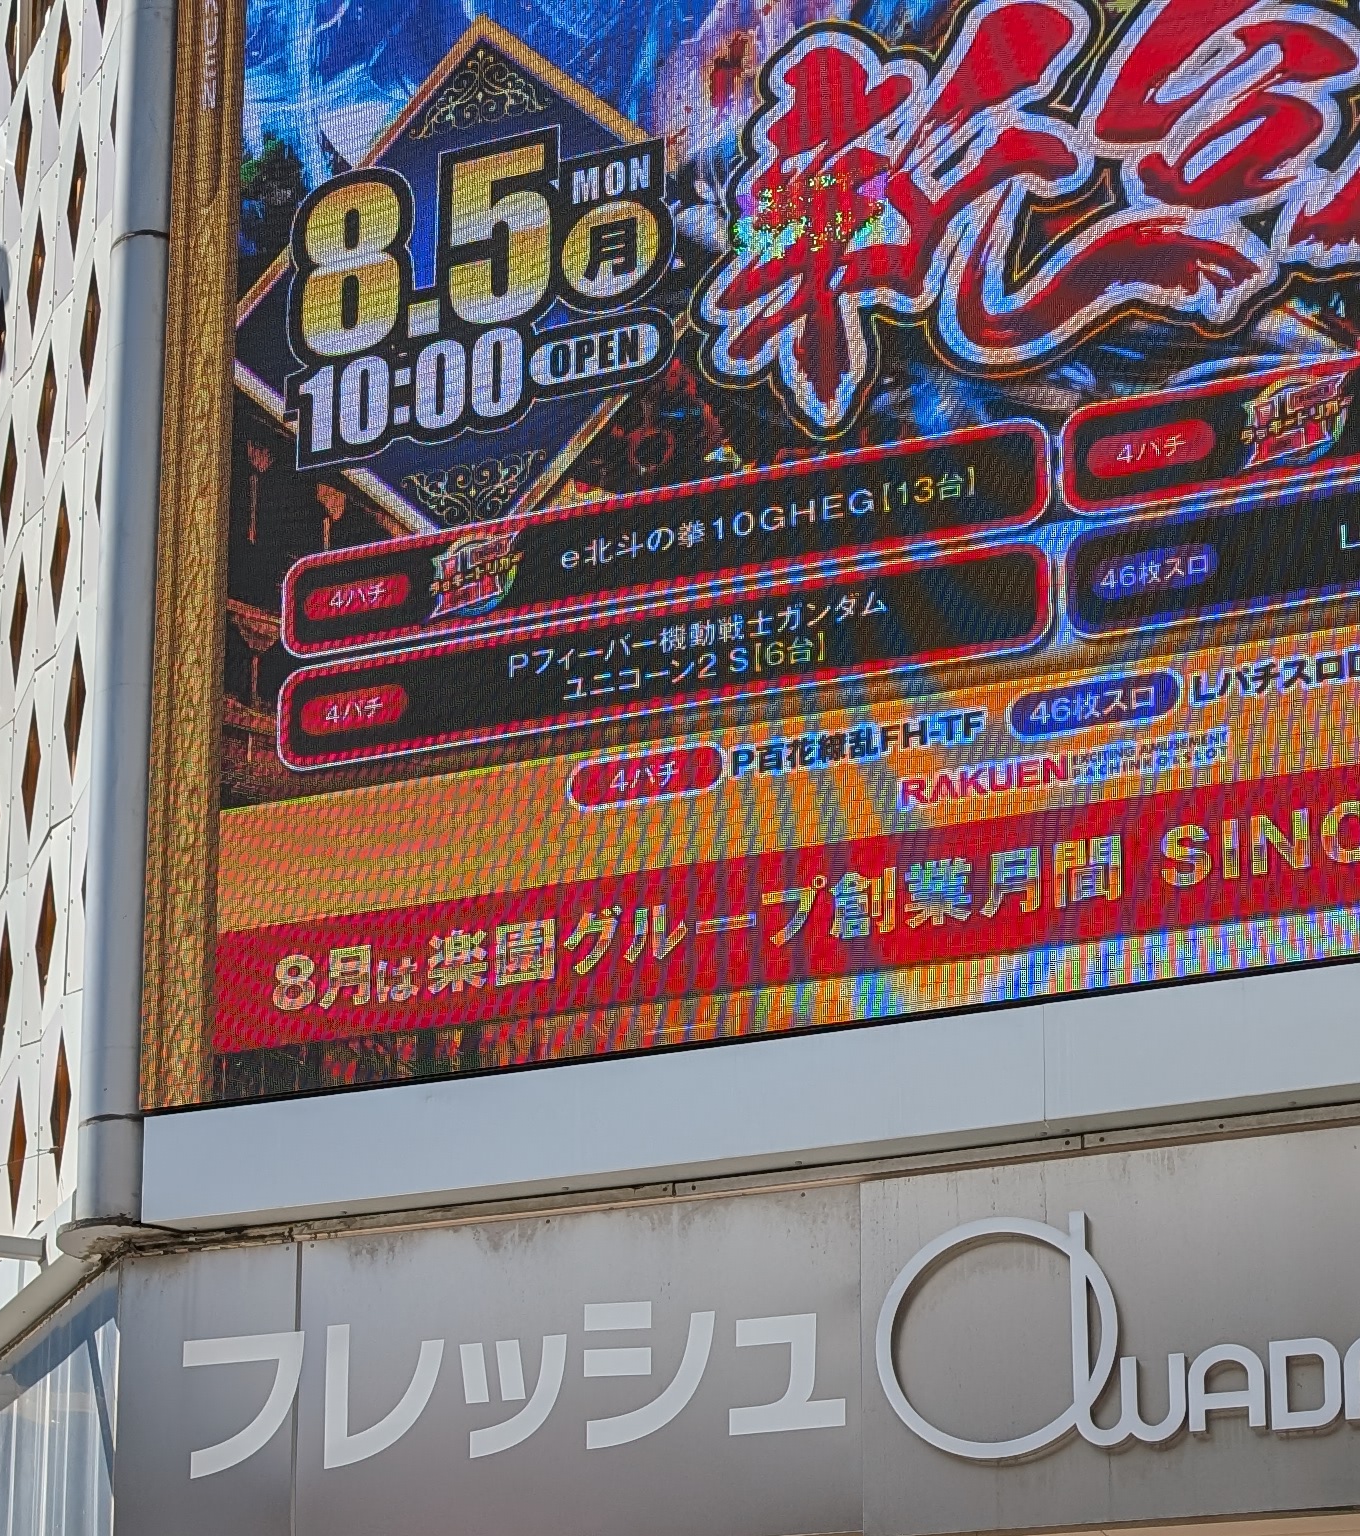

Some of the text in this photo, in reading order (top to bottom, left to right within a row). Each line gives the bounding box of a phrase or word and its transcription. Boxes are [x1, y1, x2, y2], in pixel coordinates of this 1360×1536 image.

[572, 155, 651, 205] MON
[301, 143, 553, 357] 8.5
[584, 214, 642, 284] 月
[299, 328, 642, 454] 10:00 OPEN
[1115, 432, 1188, 466] 4パチ
[327, 579, 387, 610] 4パチ
[1098, 552, 1210, 596] 46枚スロ
[507, 592, 888, 680] Pフィーバー機動戦士ガンダム
[561, 653, 720, 702] ユニコーン2
[323, 695, 384, 724] 4パチ
[1028, 685, 1156, 727] 46枚スロ
[608, 710, 986, 792] 4パチ P百花繚乱FH-TF
[898, 757, 1072, 811] RAKUEN
[271, 842, 1126, 1013] 8月は楽園グループ創業月間
[182, 1300, 846, 1481] フレッシュ
